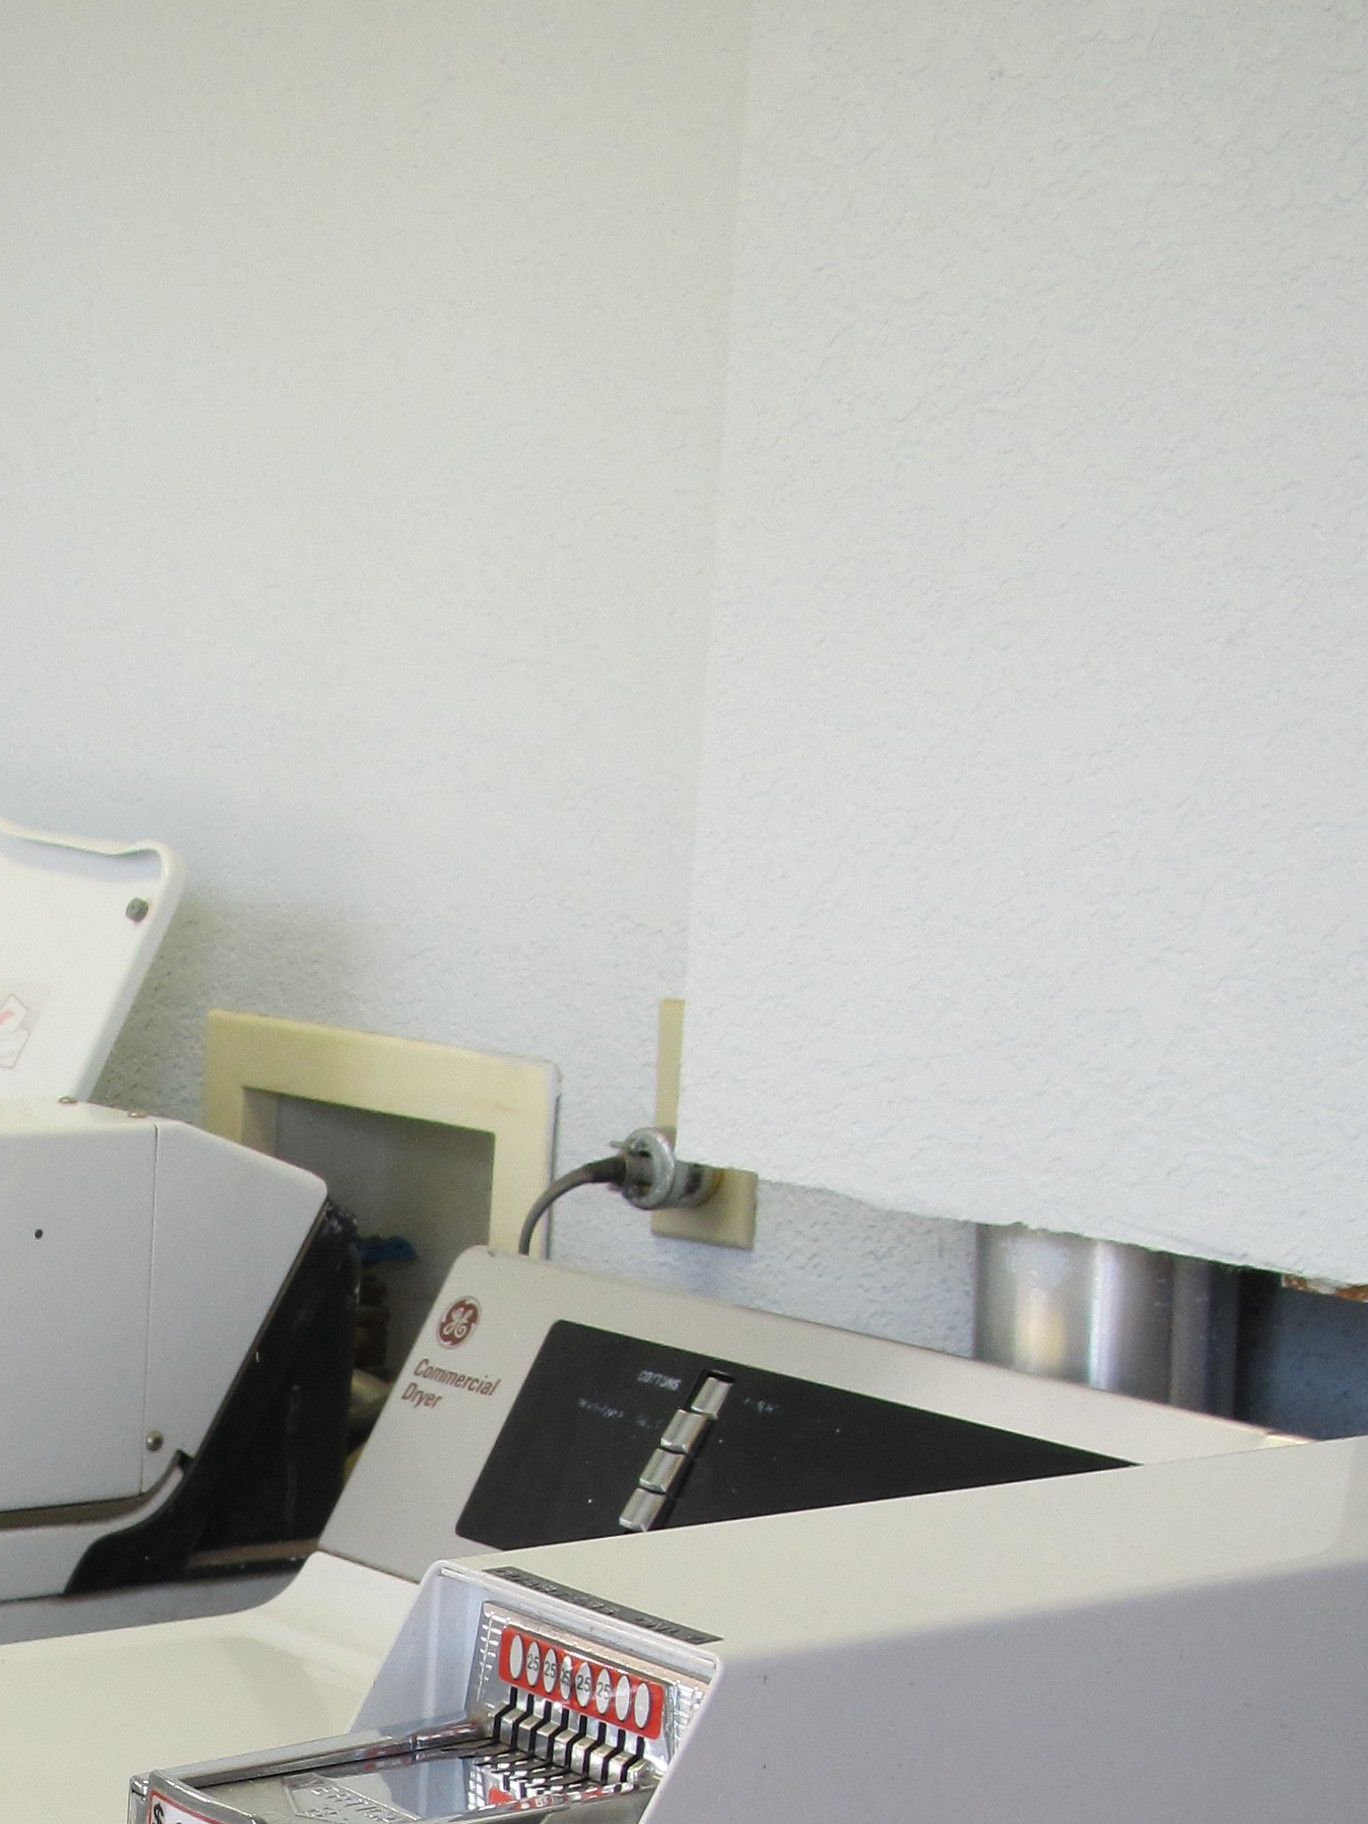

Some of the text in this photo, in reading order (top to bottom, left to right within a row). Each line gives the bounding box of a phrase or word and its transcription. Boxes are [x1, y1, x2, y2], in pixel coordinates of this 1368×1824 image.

[401, 1381, 443, 1408] Dryer
[413, 1357, 502, 1396] Commercial
[527, 1652, 539, 1671] 25
[544, 1660, 556, 1678] 25
[577, 1674, 592, 1692] 25
[596, 1681, 612, 1700] 25
